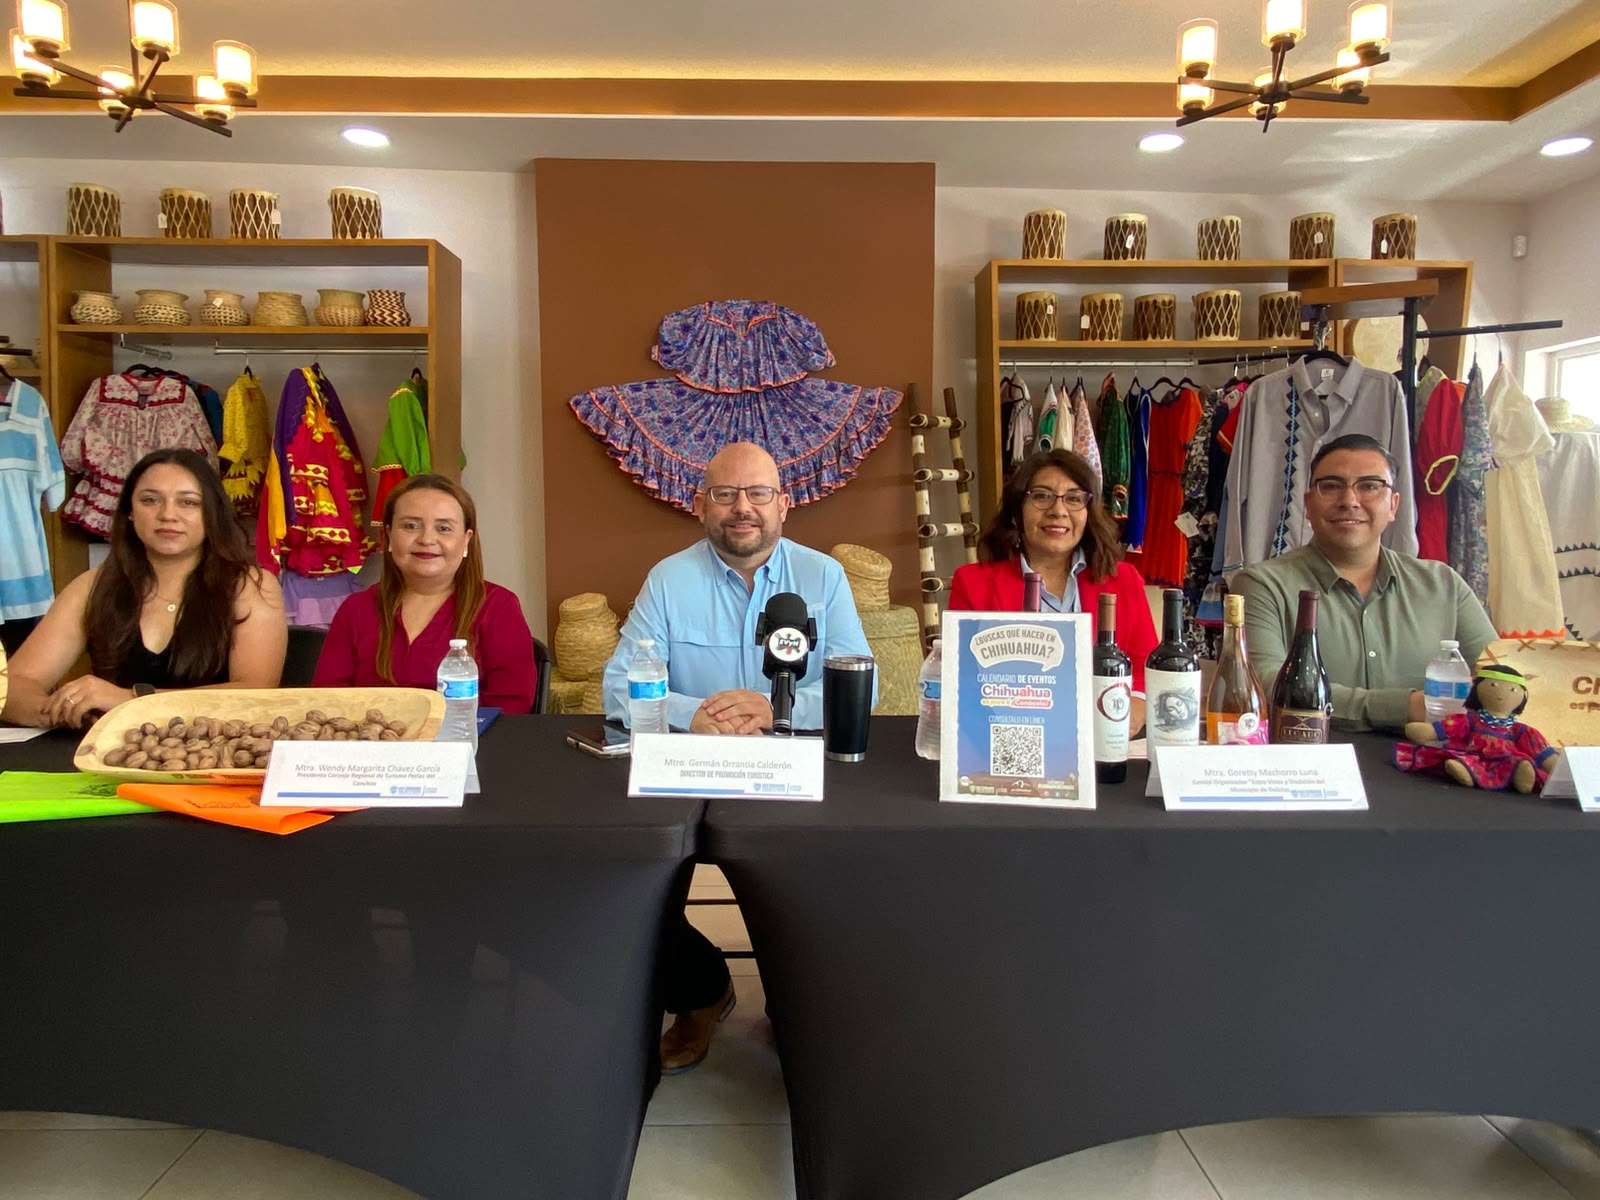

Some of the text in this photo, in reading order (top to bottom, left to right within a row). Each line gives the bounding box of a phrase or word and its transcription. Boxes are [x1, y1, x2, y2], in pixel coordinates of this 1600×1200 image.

[1022, 629, 1045, 640] HACER
[1046, 634, 1056, 642] EN
[981, 642, 1055, 659] CHIHUAHUA?
[977, 673, 1057, 684] CALENDARIO DE EVENTOS
[982, 685, 1051, 698] Chihuahua
[319, 763, 346, 774] Wendy
[347, 763, 385, 774] Margarita
[756, 760, 792, 770] Calderón
